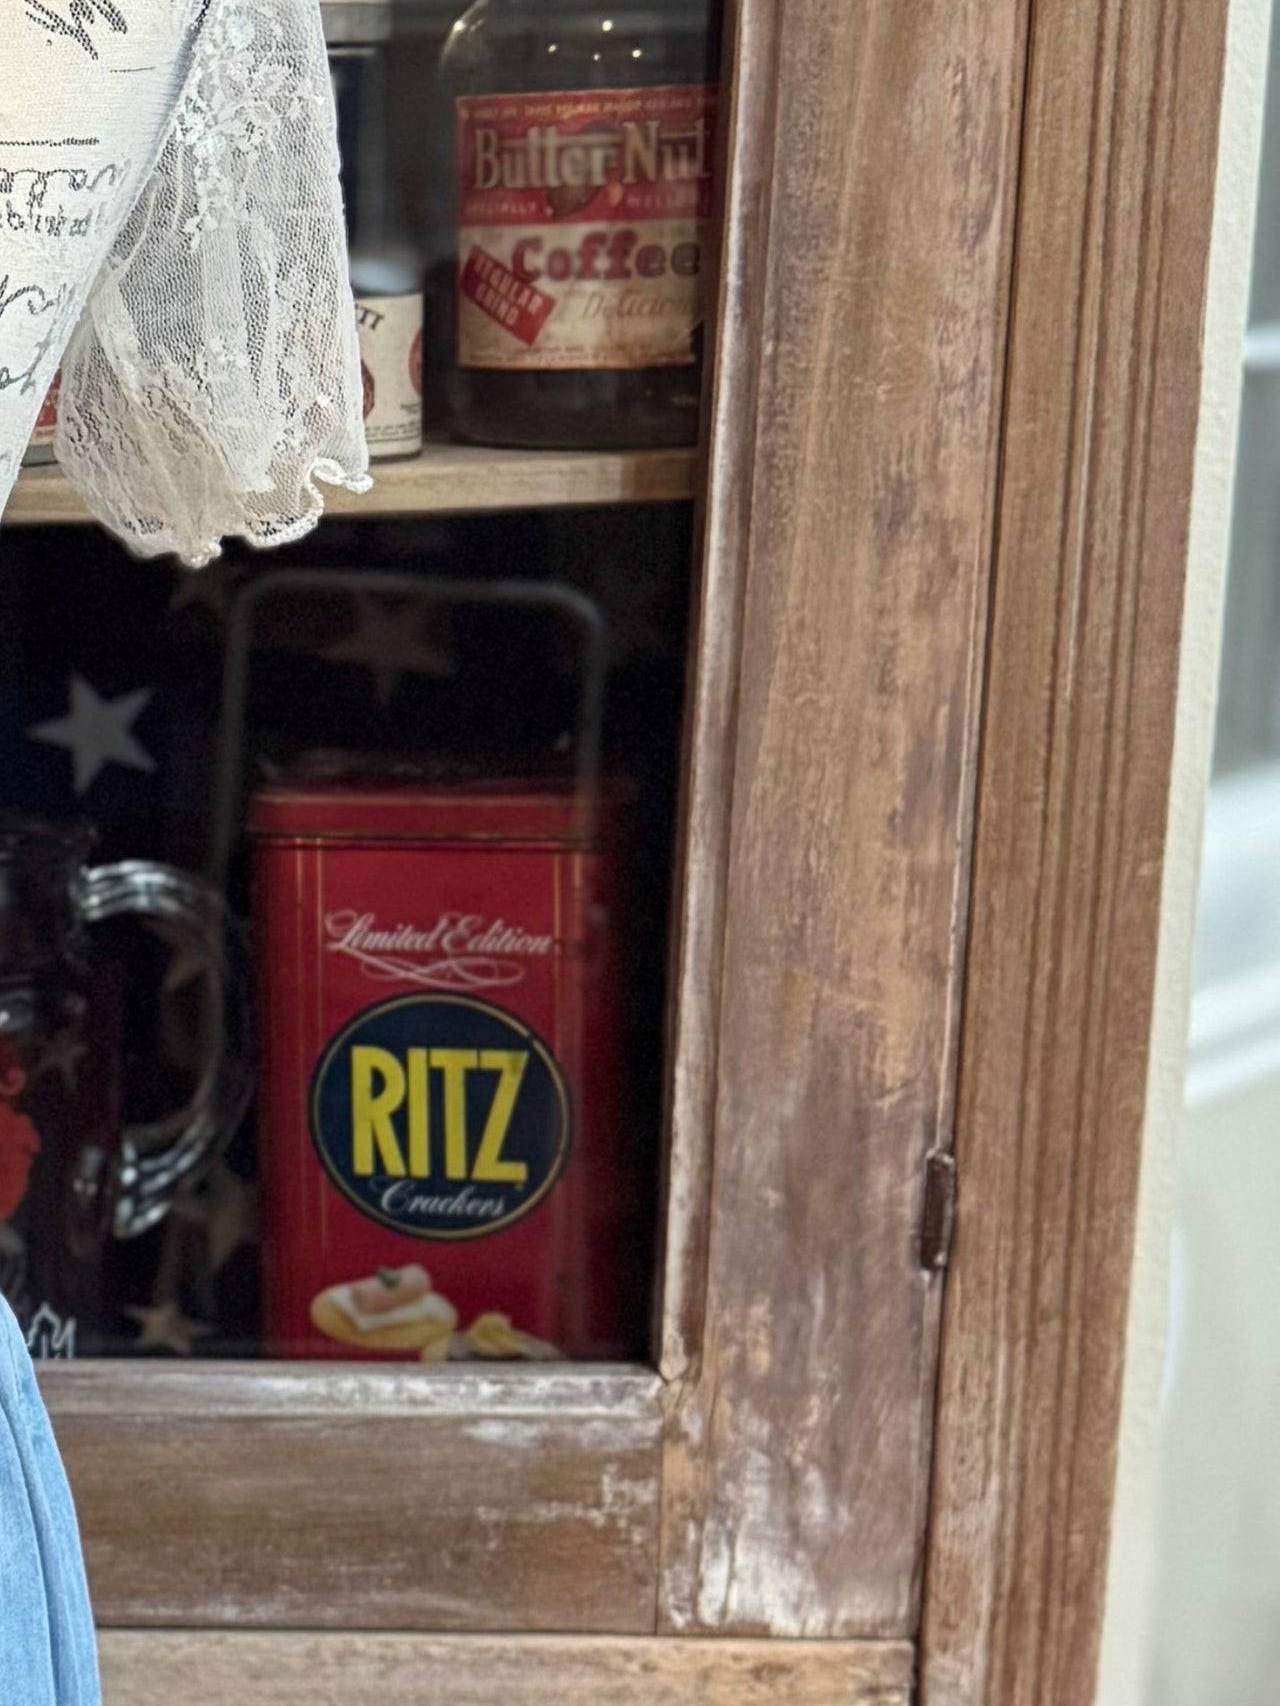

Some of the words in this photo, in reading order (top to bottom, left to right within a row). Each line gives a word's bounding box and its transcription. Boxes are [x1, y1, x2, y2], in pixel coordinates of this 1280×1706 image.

[512, 229, 701, 283] Coffee
[325, 910, 444, 954] Limited
[443, 911, 557, 956] Edition
[350, 1045, 530, 1184] RITZ
[371, 1176, 505, 1219] Crackers
